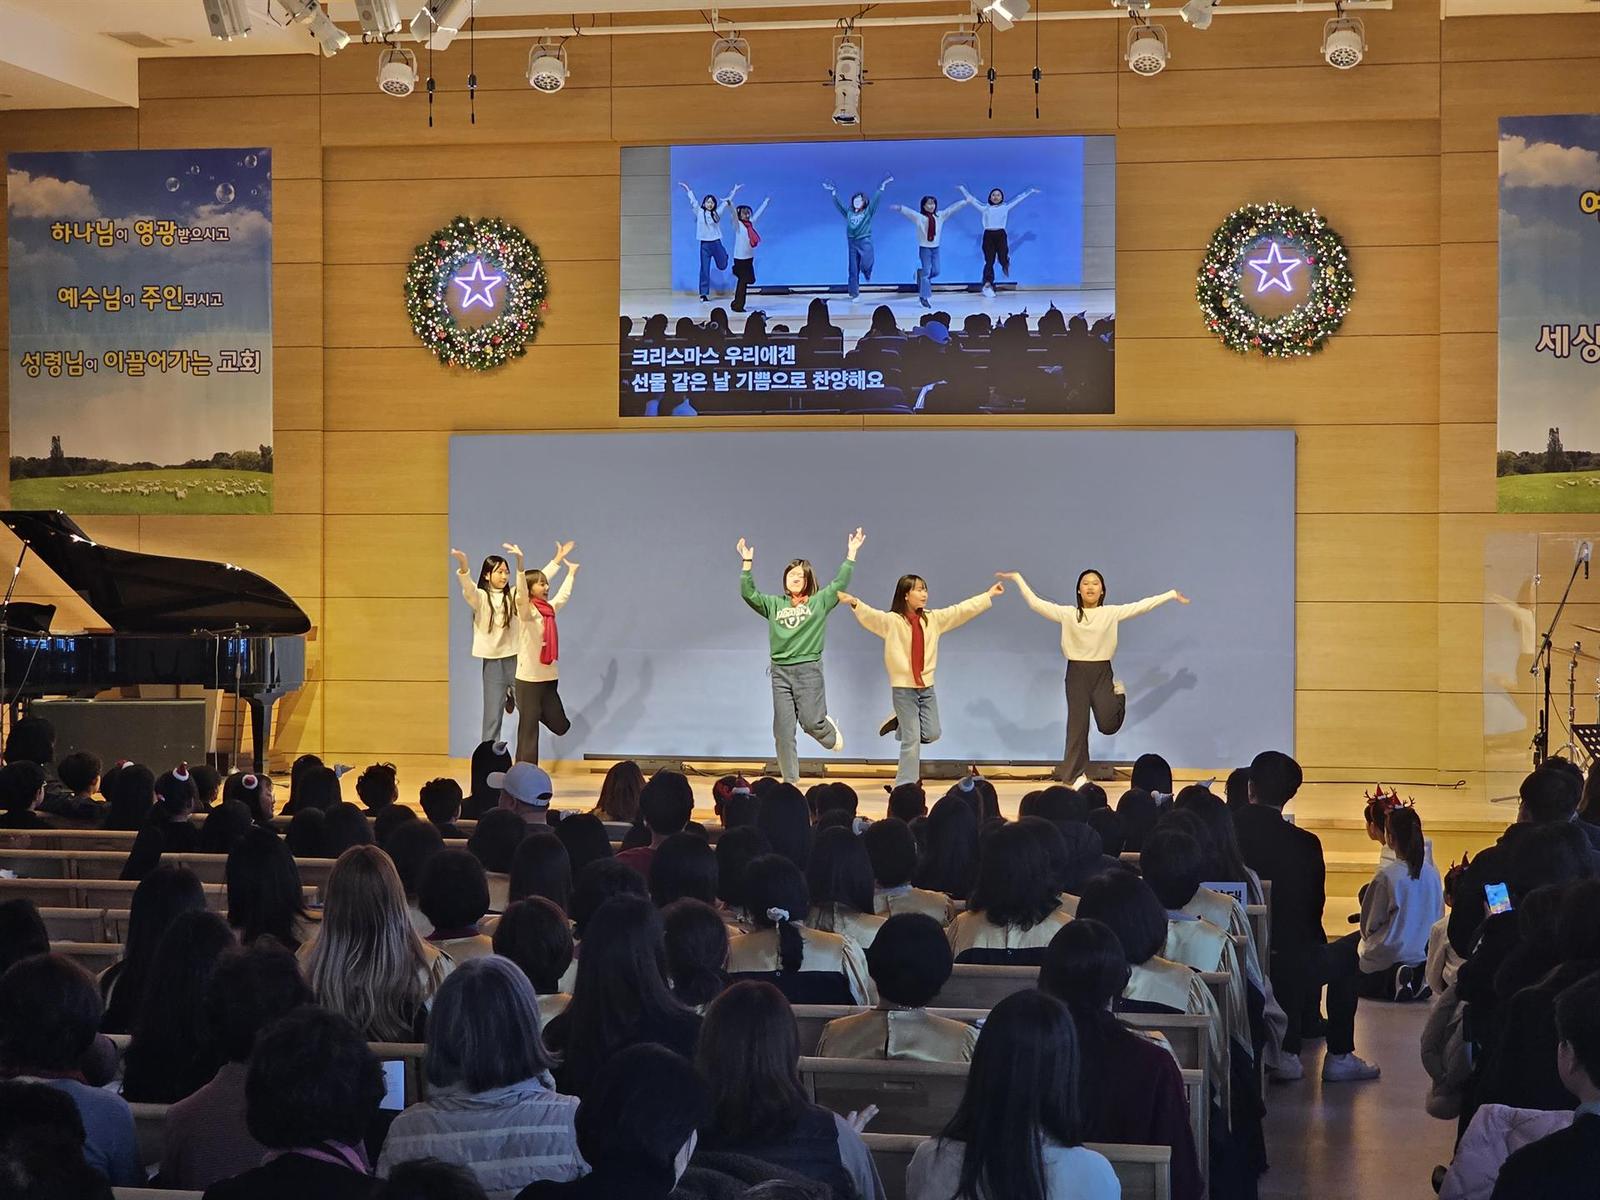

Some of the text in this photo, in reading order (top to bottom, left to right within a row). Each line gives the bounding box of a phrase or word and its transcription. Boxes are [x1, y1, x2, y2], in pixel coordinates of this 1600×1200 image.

[51, 220, 230, 247] 하나님이 영광받으시고
[57, 285, 223, 311] 예수님이 주인되시고
[21, 349, 261, 377] 성령님이 이끌어가는 교회
[631, 345, 796, 367] 크리스마스 우리에겐
[631, 370, 885, 392] 선물 같은 날 기쁨으로 찬양해요
